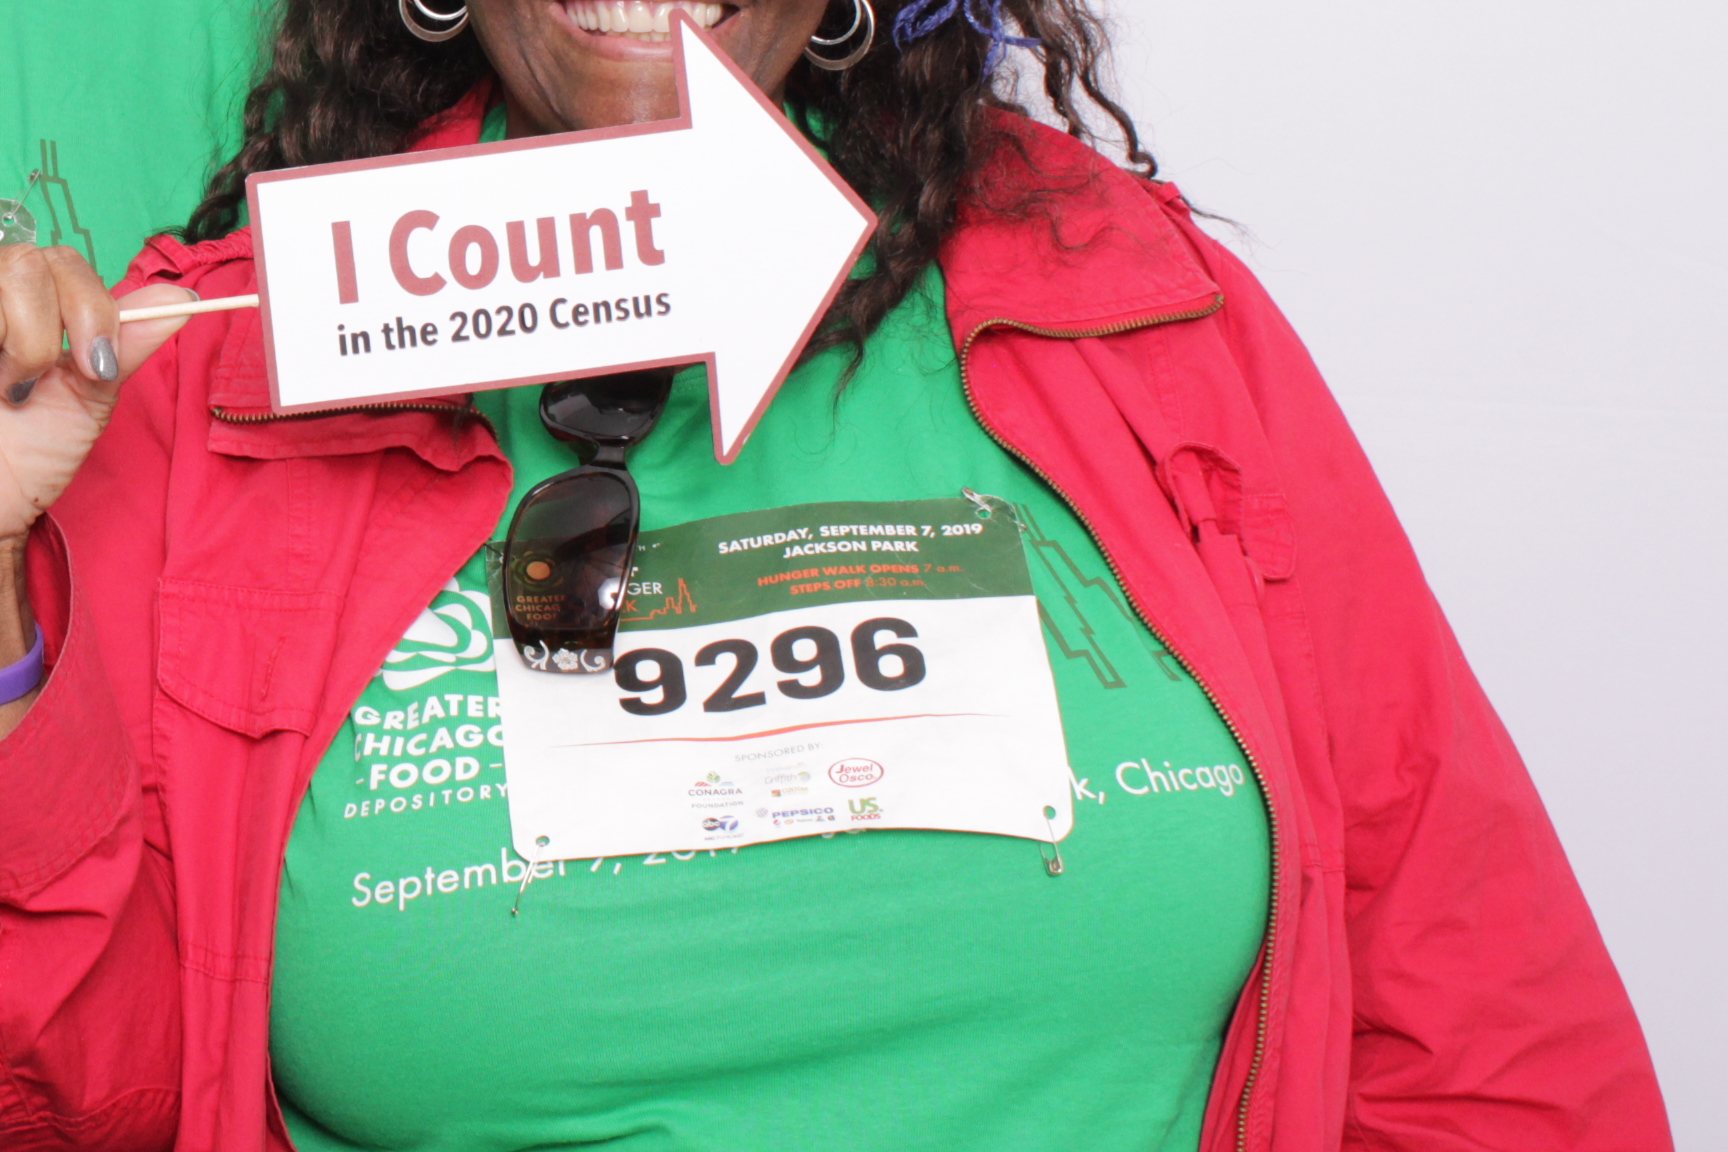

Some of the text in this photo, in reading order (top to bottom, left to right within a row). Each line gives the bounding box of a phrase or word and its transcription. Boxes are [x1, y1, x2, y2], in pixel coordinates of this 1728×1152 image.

[330, 189, 665, 305] I Count
[338, 290, 672, 357] in the 2020 Census
[718, 523, 983, 554] SATURDAY, SEPTEMBER 7, 2019
[783, 541, 920, 559] JACKSON PARK
[757, 568, 820, 587] HUNGER
[823, 564, 866, 576] WALK
[869, 563, 920, 574] OPENS
[627, 582, 663, 595] GER
[790, 582, 831, 595] STEPS
[834, 579, 861, 590] OFF
[515, 604, 561, 612] CHICAG
[613, 617, 927, 716] 9296
[734, 745, 805, 762] SPONSORED
[835, 763, 874, 775] Jewel
[1115, 758, 1246, 797] Chicago
[688, 787, 743, 797] CONAGRA
[691, 800, 744, 809] FOUNDATION
[772, 806, 834, 818] PEPSICO
[851, 813, 881, 821] FOODS
